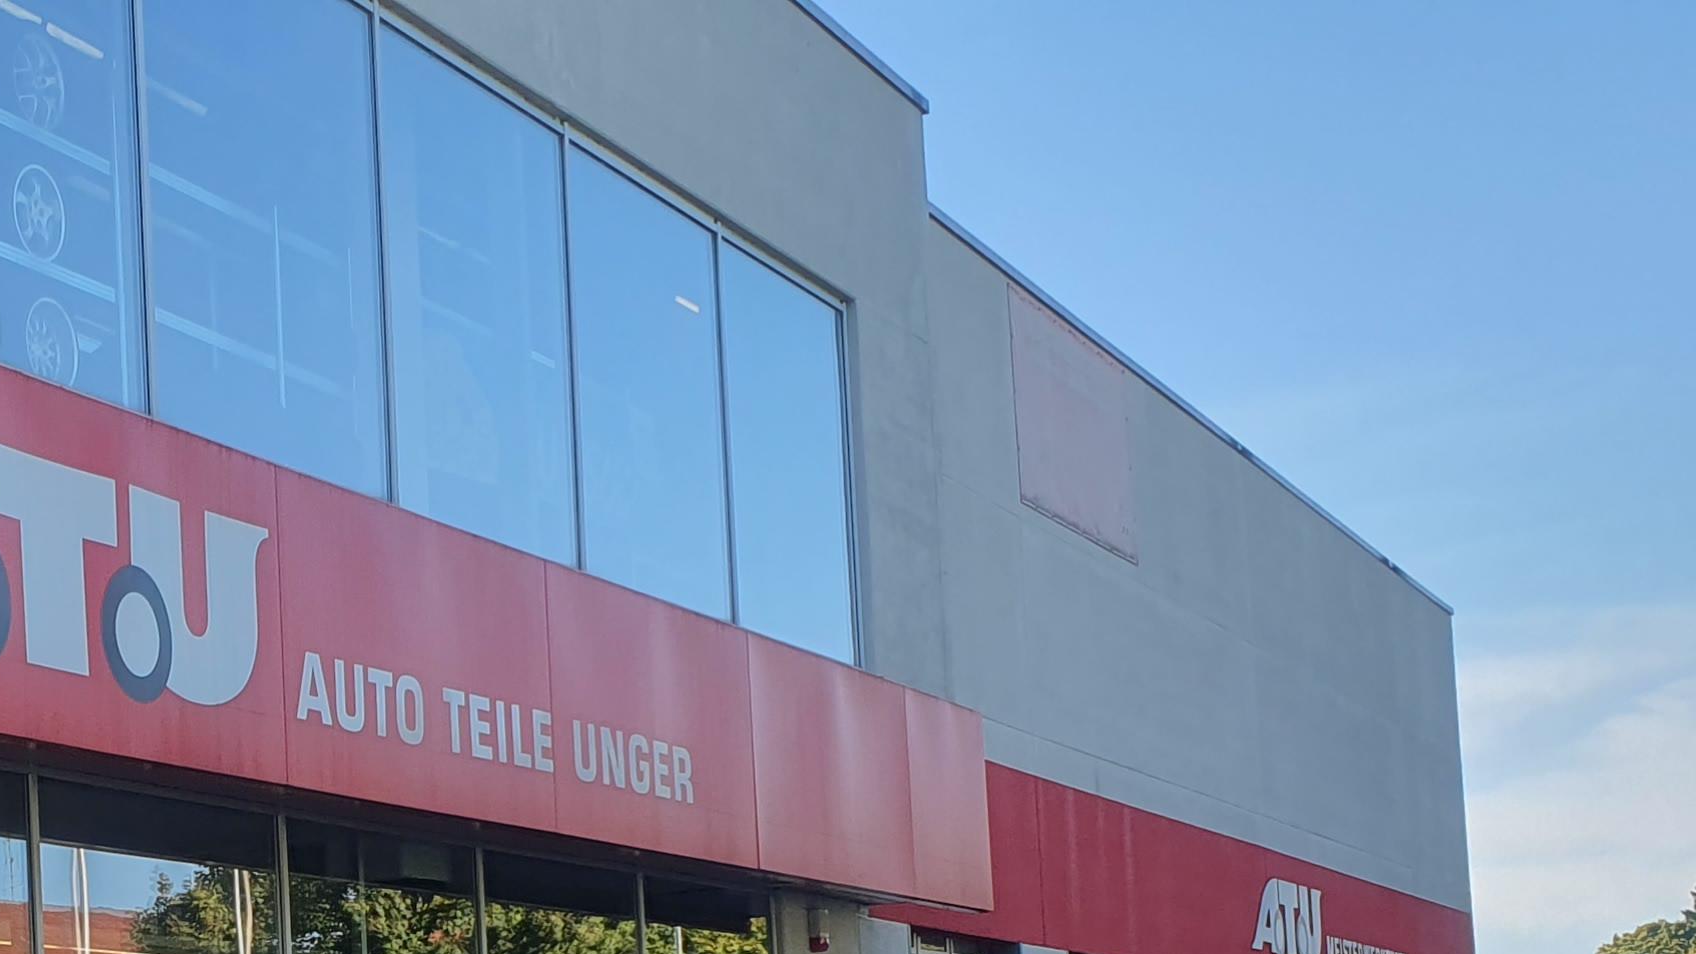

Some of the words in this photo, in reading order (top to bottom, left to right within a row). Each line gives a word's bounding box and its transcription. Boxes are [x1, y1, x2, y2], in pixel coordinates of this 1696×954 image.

[296, 651, 425, 746] AUTO
[442, 687, 555, 774] TEILE
[572, 719, 695, 805] UNGER
